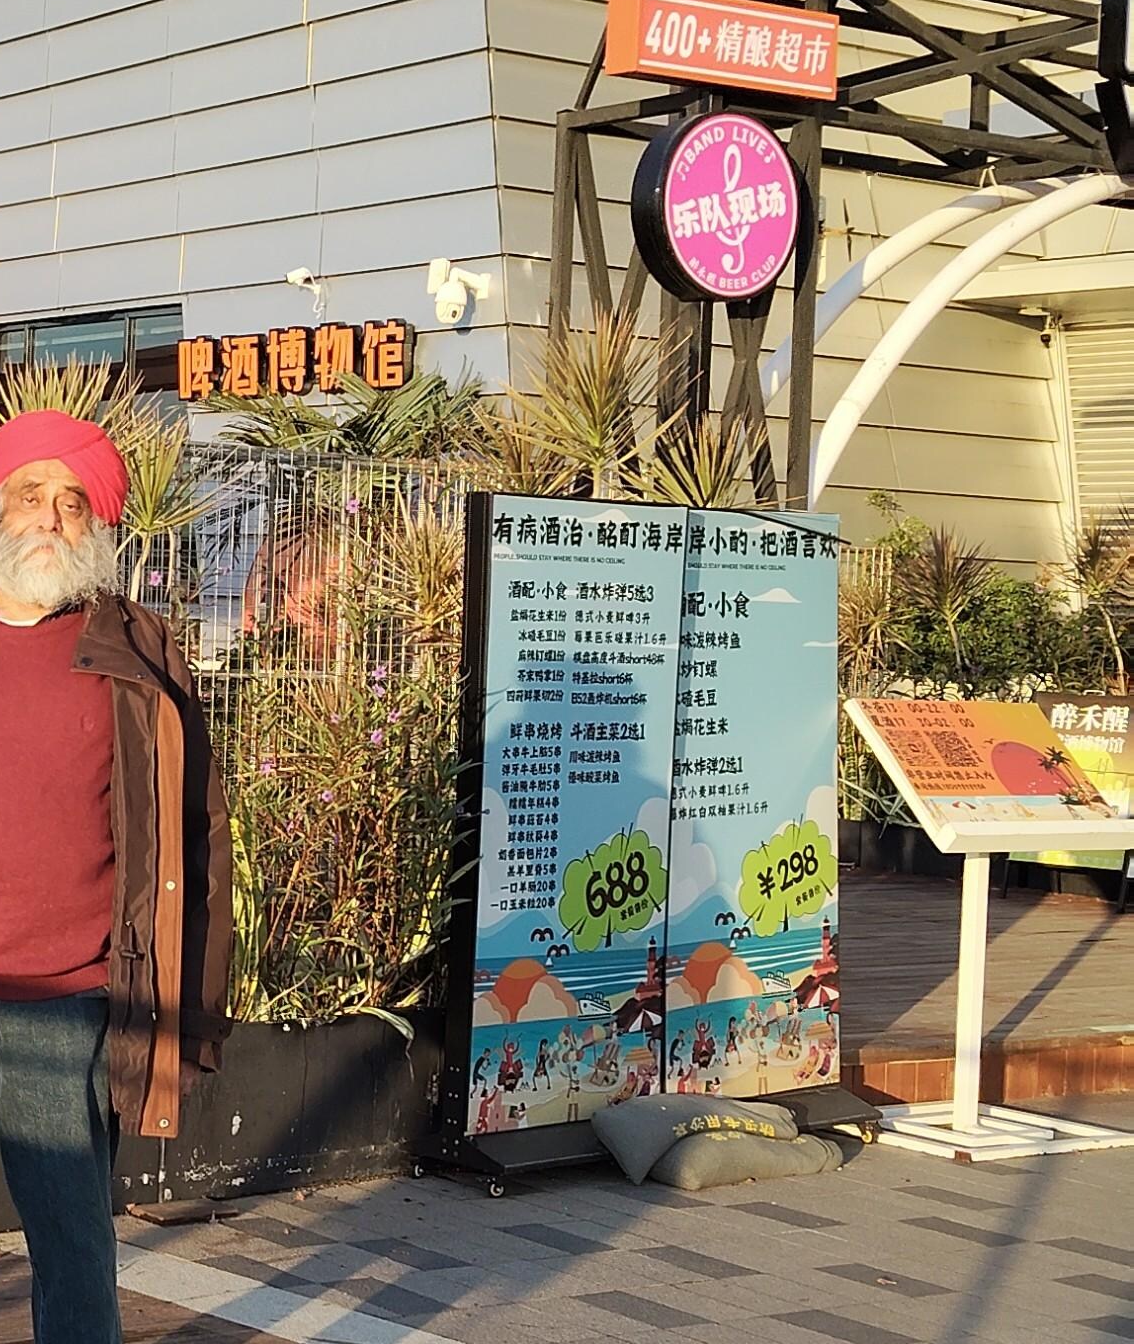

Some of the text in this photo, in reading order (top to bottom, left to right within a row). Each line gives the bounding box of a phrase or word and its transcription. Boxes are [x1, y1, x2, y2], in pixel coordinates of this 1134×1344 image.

[684, 126, 768, 165] BAND LIVE
[672, 181, 787, 238] 乐队现场
[718, 272, 749, 288] BEER
[751, 254, 778, 281] CLUP
[177, 319, 407, 401] 啤酒博物馆
[493, 513, 683, 554] 有病酒治·酩酊海岸
[516, 553, 538, 561] SHOULD
[575, 582, 654, 603] 酒水炸弹5选3
[509, 722, 563, 741] 鲜串烧烤
[570, 722, 646, 742] 斗酒主菜2选1
[1051, 702, 1130, 734] 醉禾醒
[585, 850, 650, 918] 688
